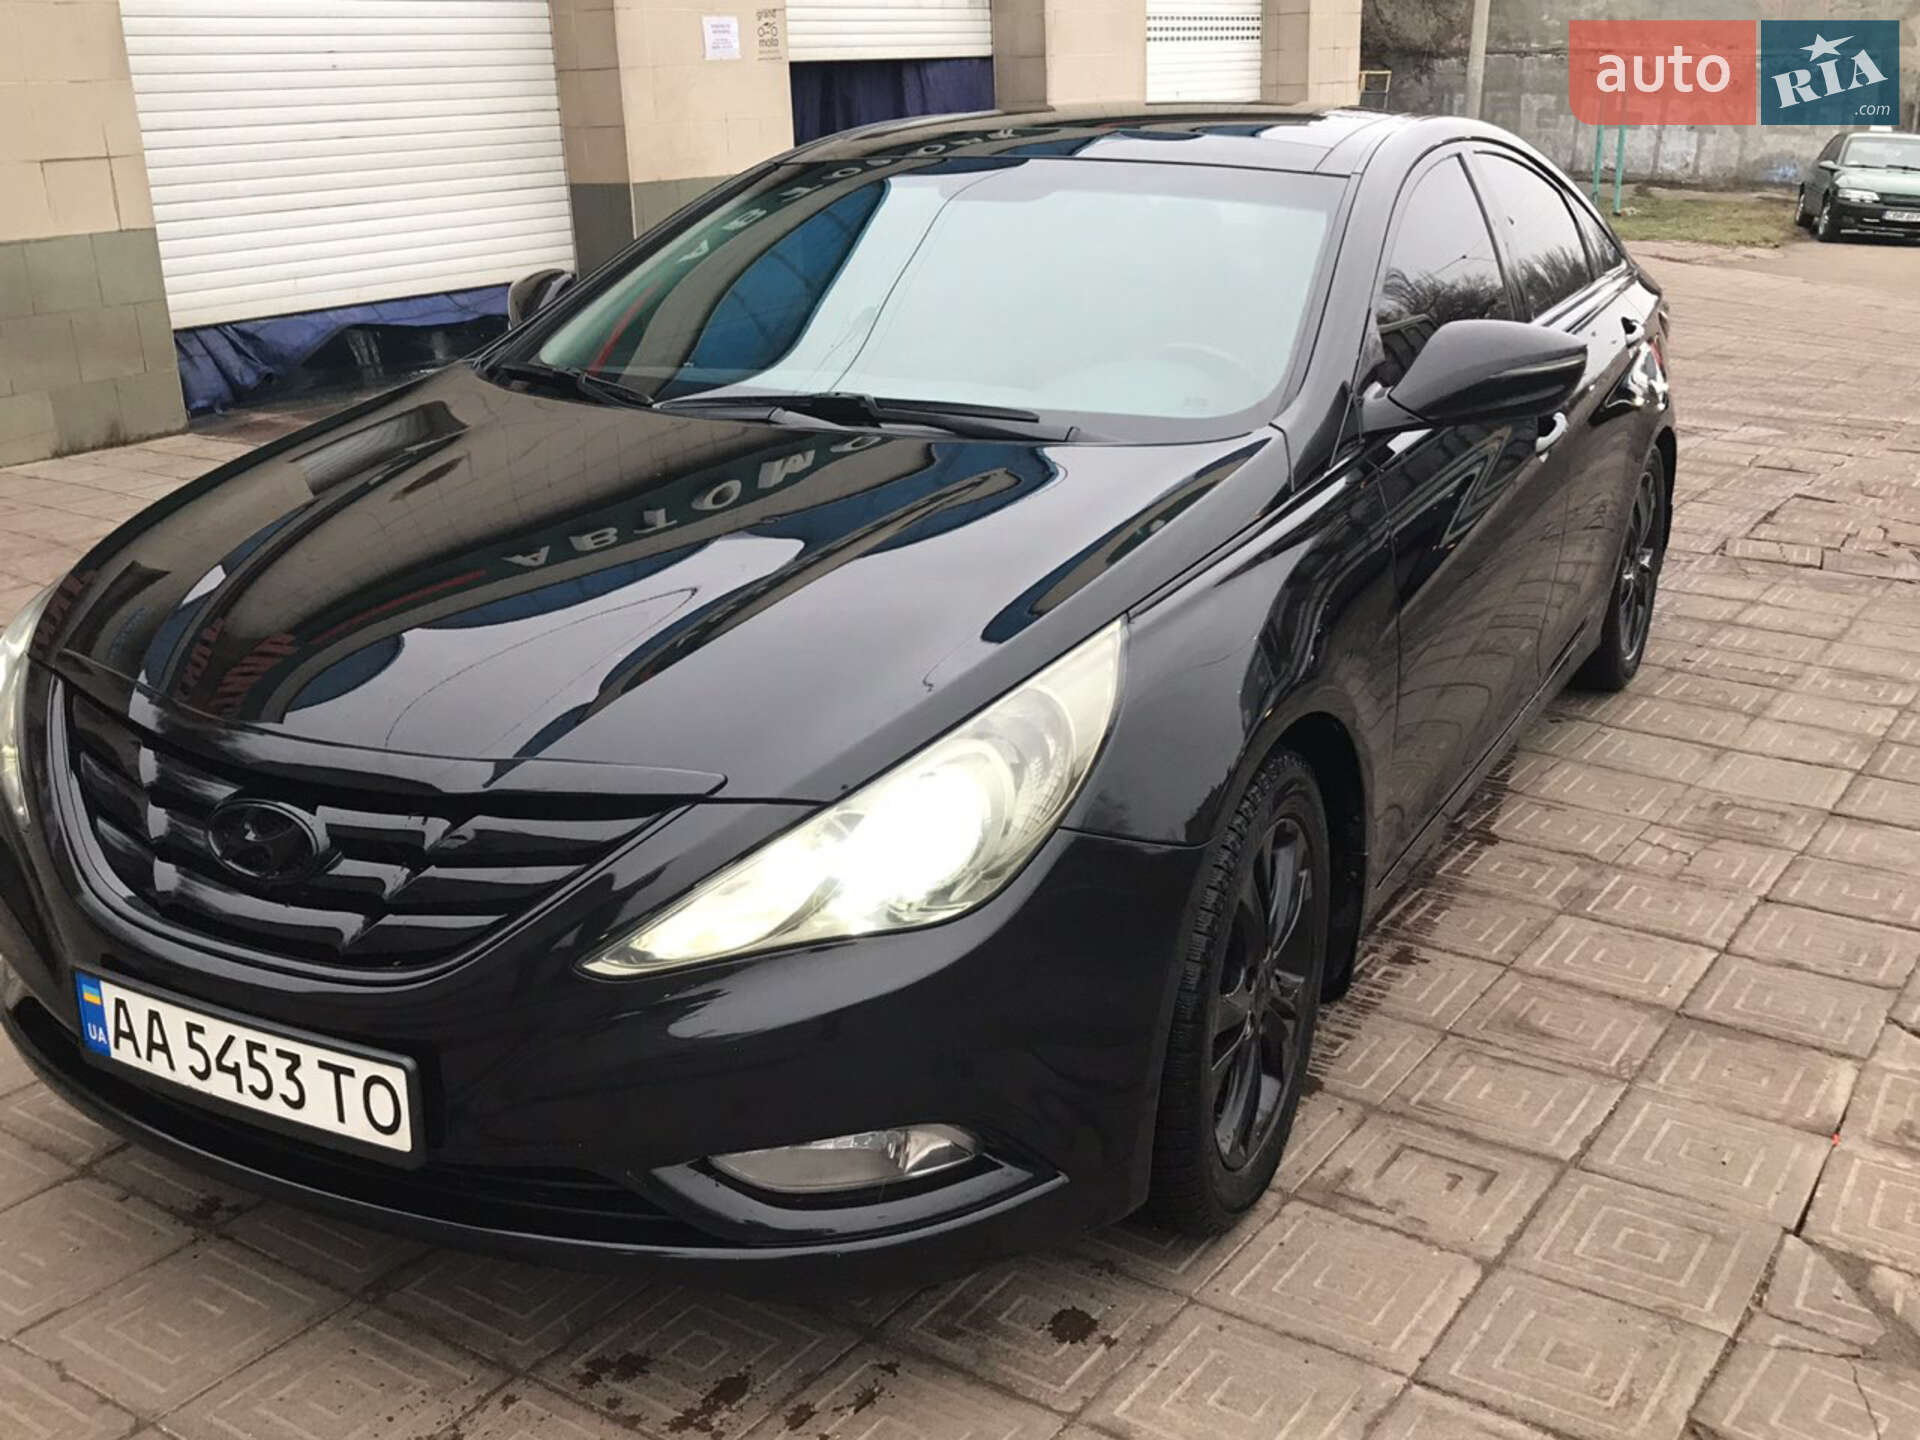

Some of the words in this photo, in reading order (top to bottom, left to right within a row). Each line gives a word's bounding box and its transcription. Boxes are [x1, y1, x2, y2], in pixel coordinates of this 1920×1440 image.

[87, 1023, 108, 1045] UA
[113, 997, 176, 1072] AA
[185, 1021, 306, 1111] 5453
[318, 1060, 402, 1136] TO
